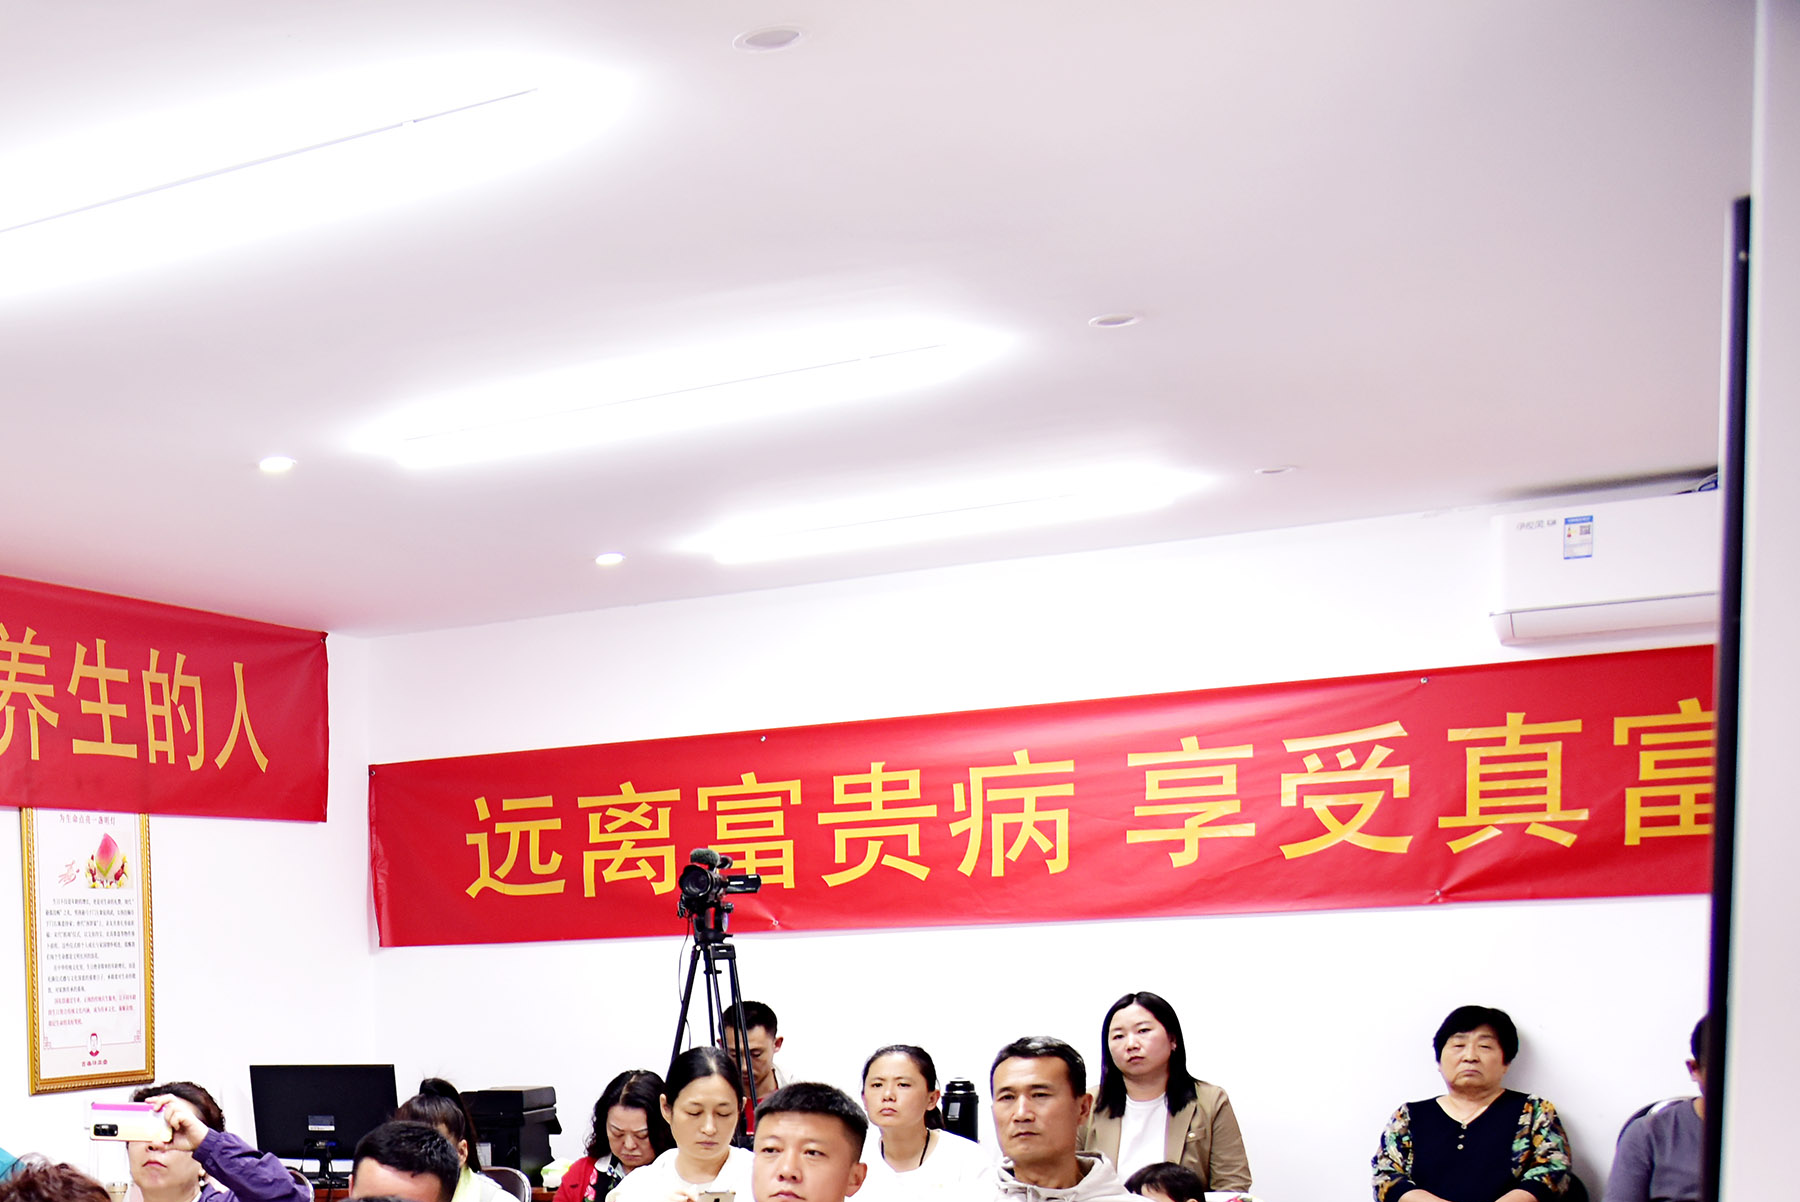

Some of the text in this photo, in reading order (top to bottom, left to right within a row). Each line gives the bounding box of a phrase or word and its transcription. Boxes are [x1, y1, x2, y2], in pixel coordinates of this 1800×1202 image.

[465, 749, 1076, 898] 远离富贵病
